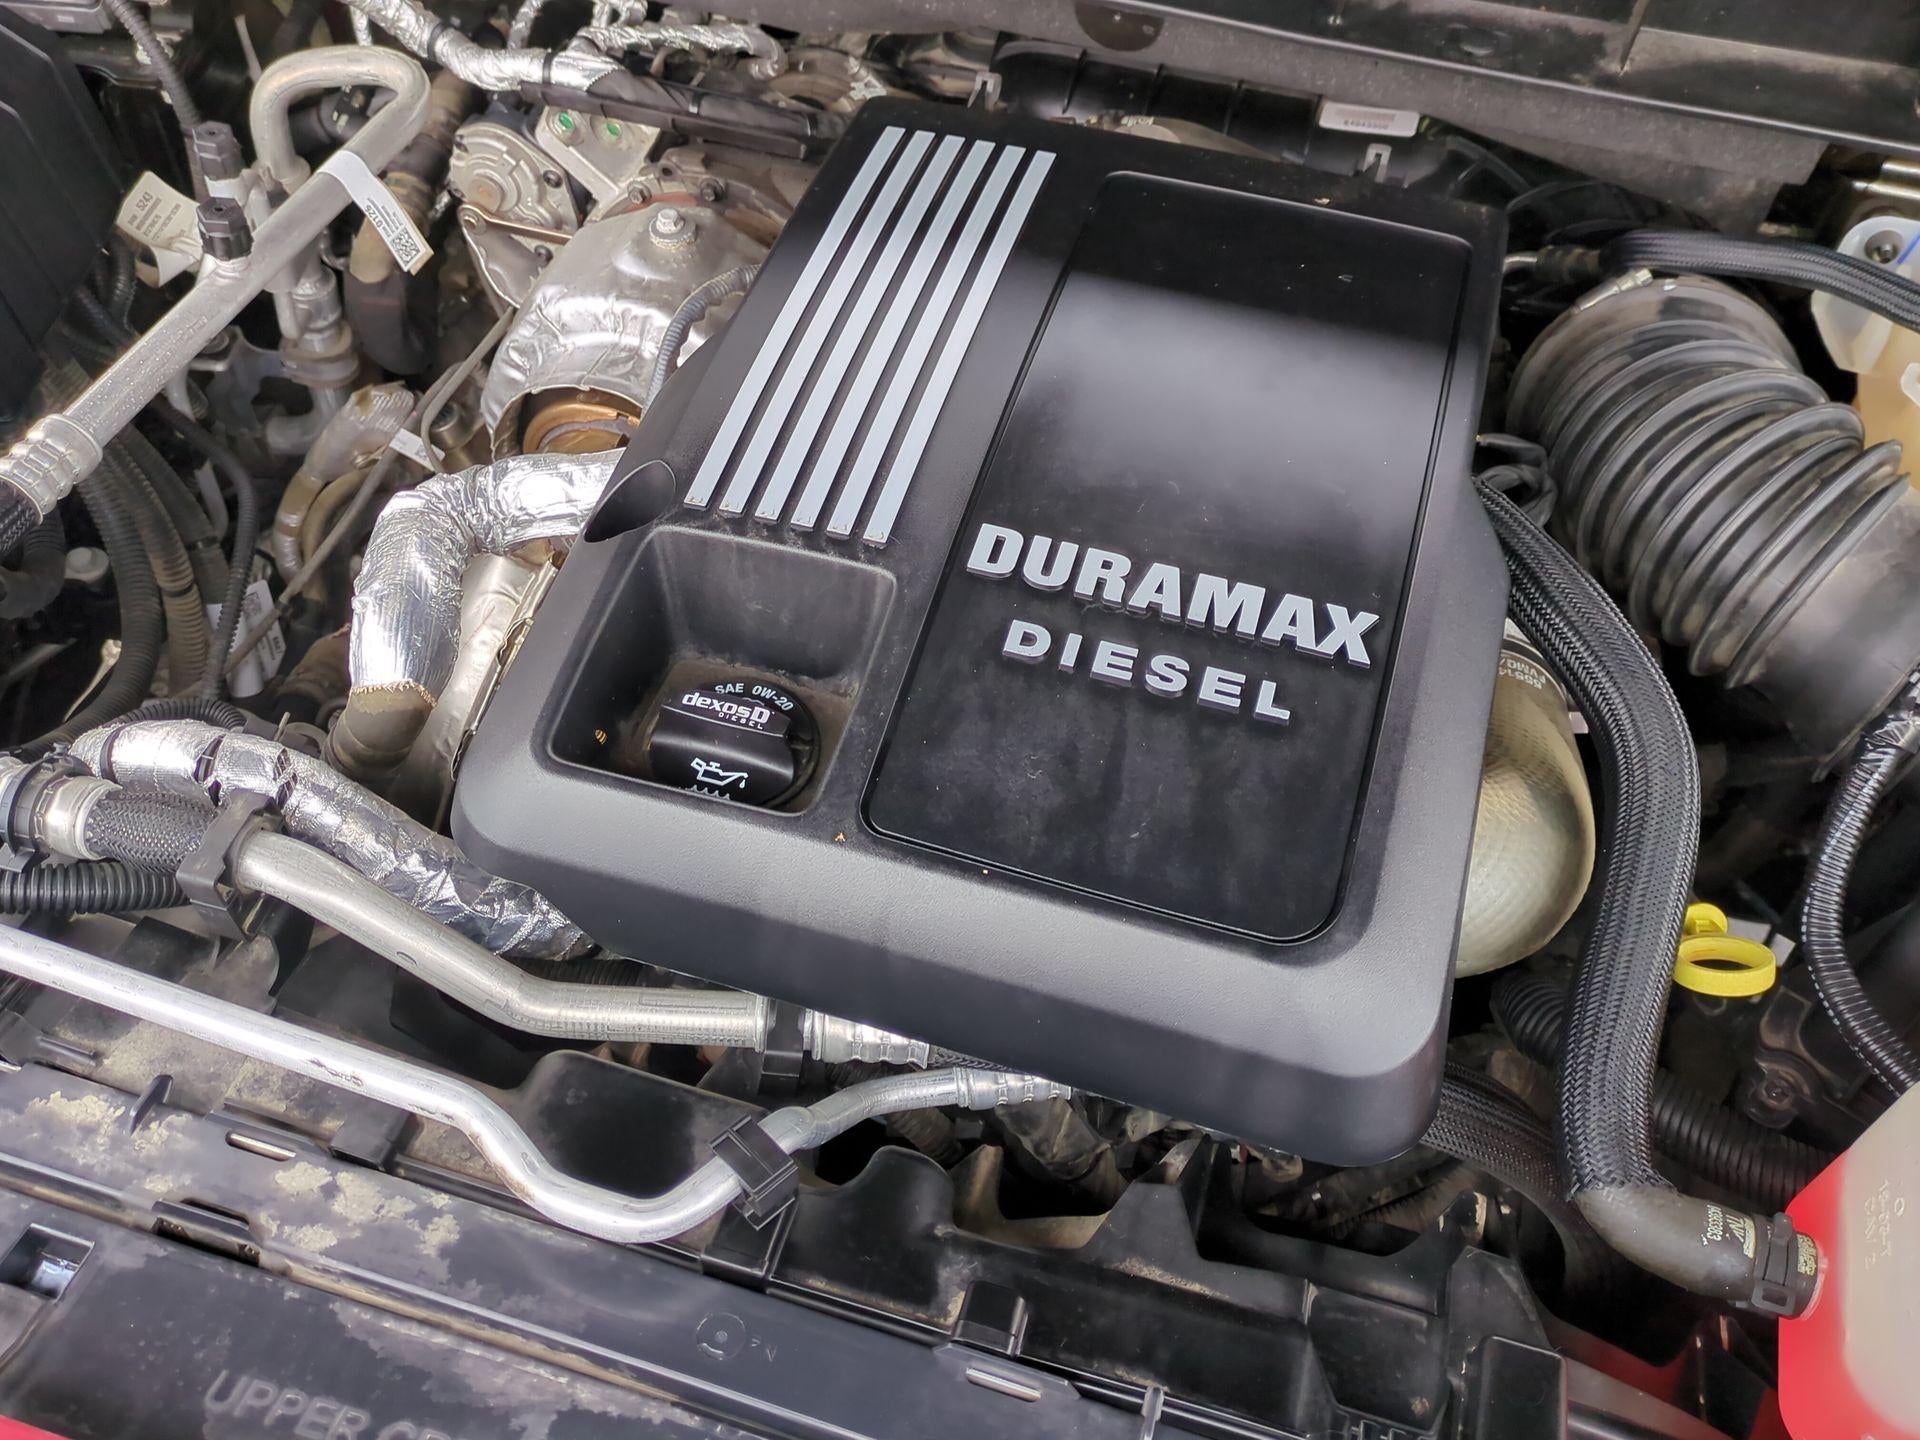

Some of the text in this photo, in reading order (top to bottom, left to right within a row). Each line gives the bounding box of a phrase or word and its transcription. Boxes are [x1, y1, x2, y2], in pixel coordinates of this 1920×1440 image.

[966, 523, 1380, 669] DURAMAX
[715, 683, 794, 711] SAE 0W-20
[1002, 619, 1291, 725] DIESEL
[718, 712, 763, 730] DIESEL
[205, 1369, 371, 1440] UPPER
